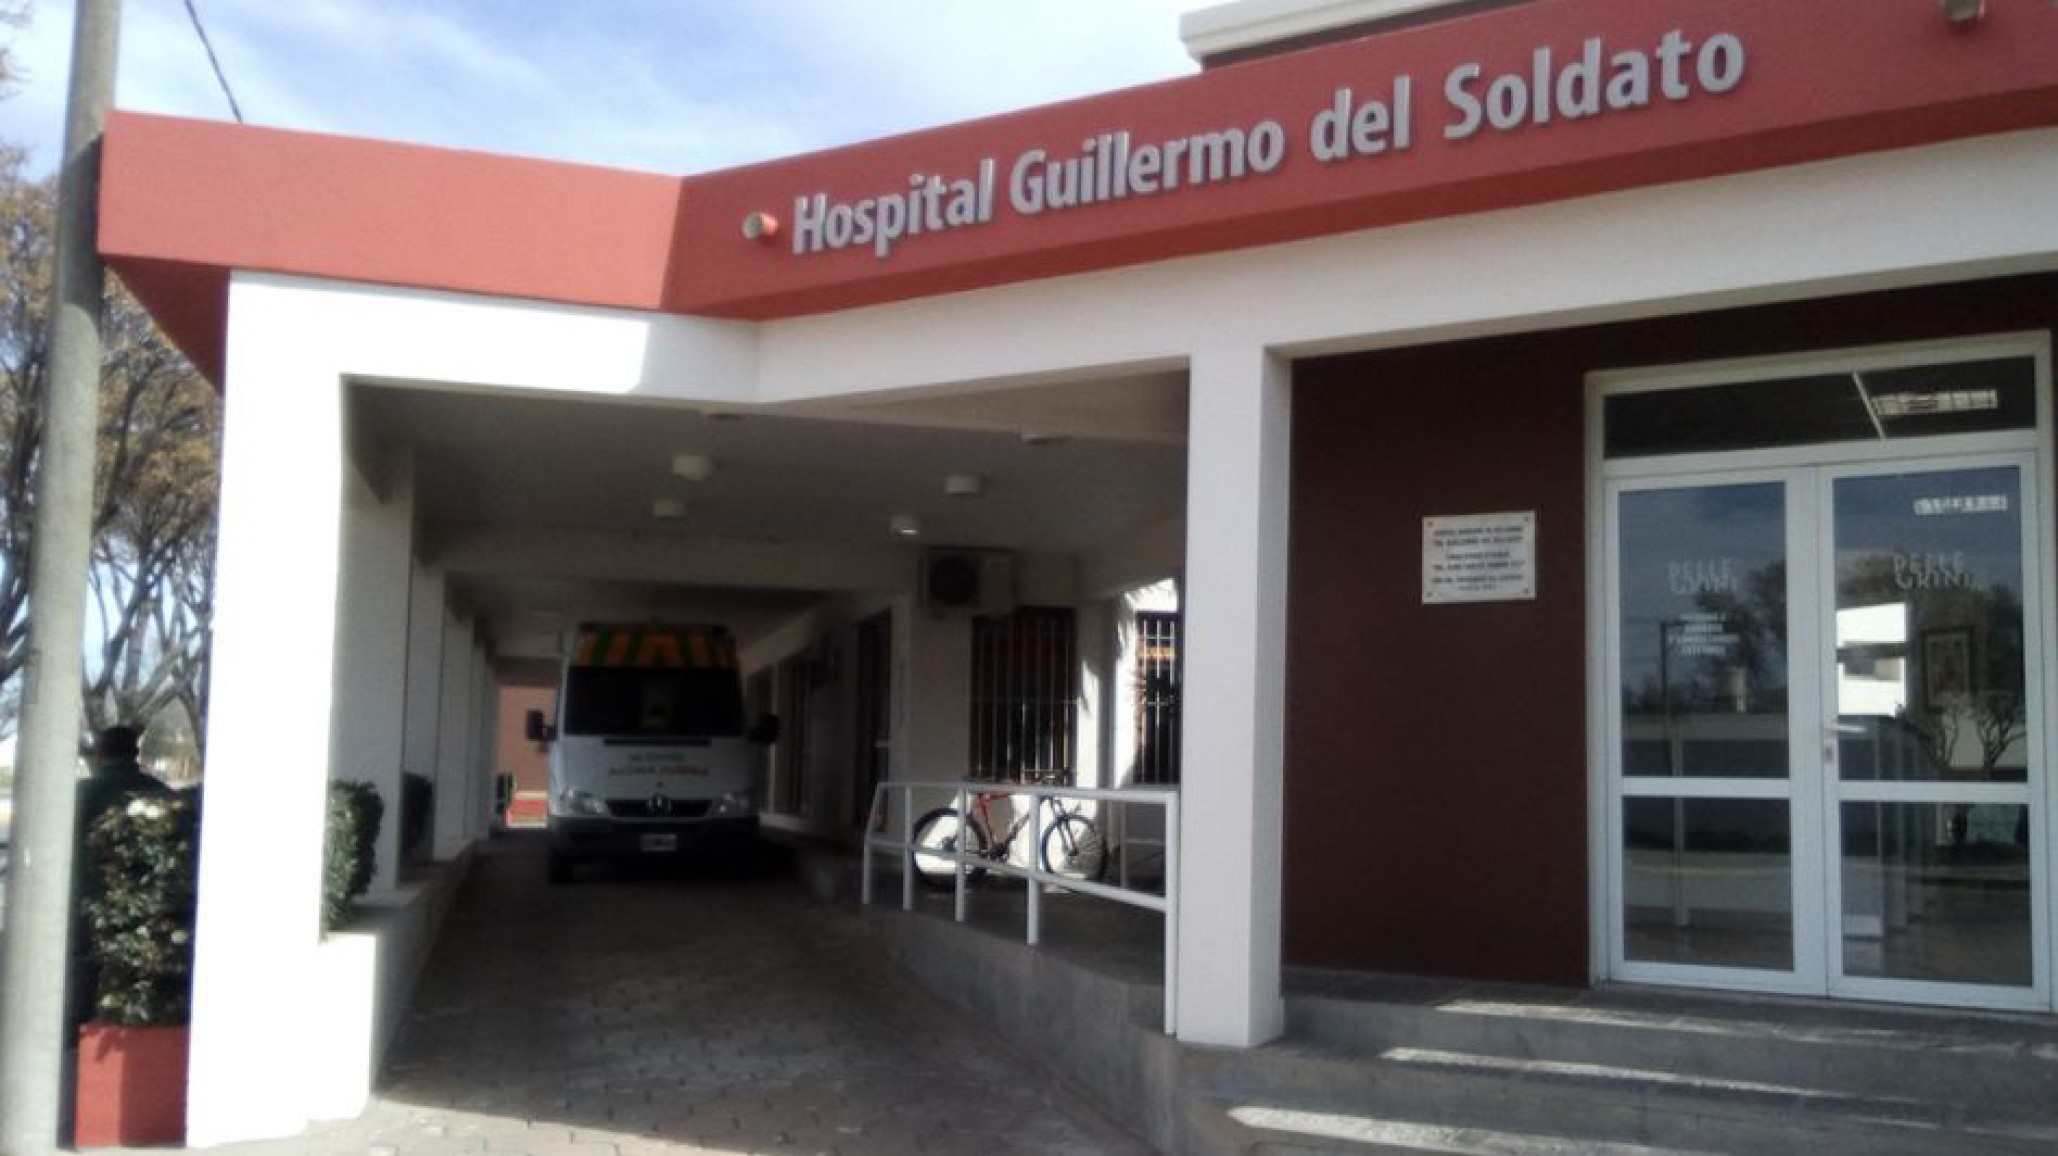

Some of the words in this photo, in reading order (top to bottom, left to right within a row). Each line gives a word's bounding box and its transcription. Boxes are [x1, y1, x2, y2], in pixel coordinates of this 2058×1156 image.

[792, 156, 997, 258] Hospital
[1008, 119, 1287, 216] Guillermo
[1310, 75, 1413, 162] del
[1443, 30, 1745, 139] Soldato
